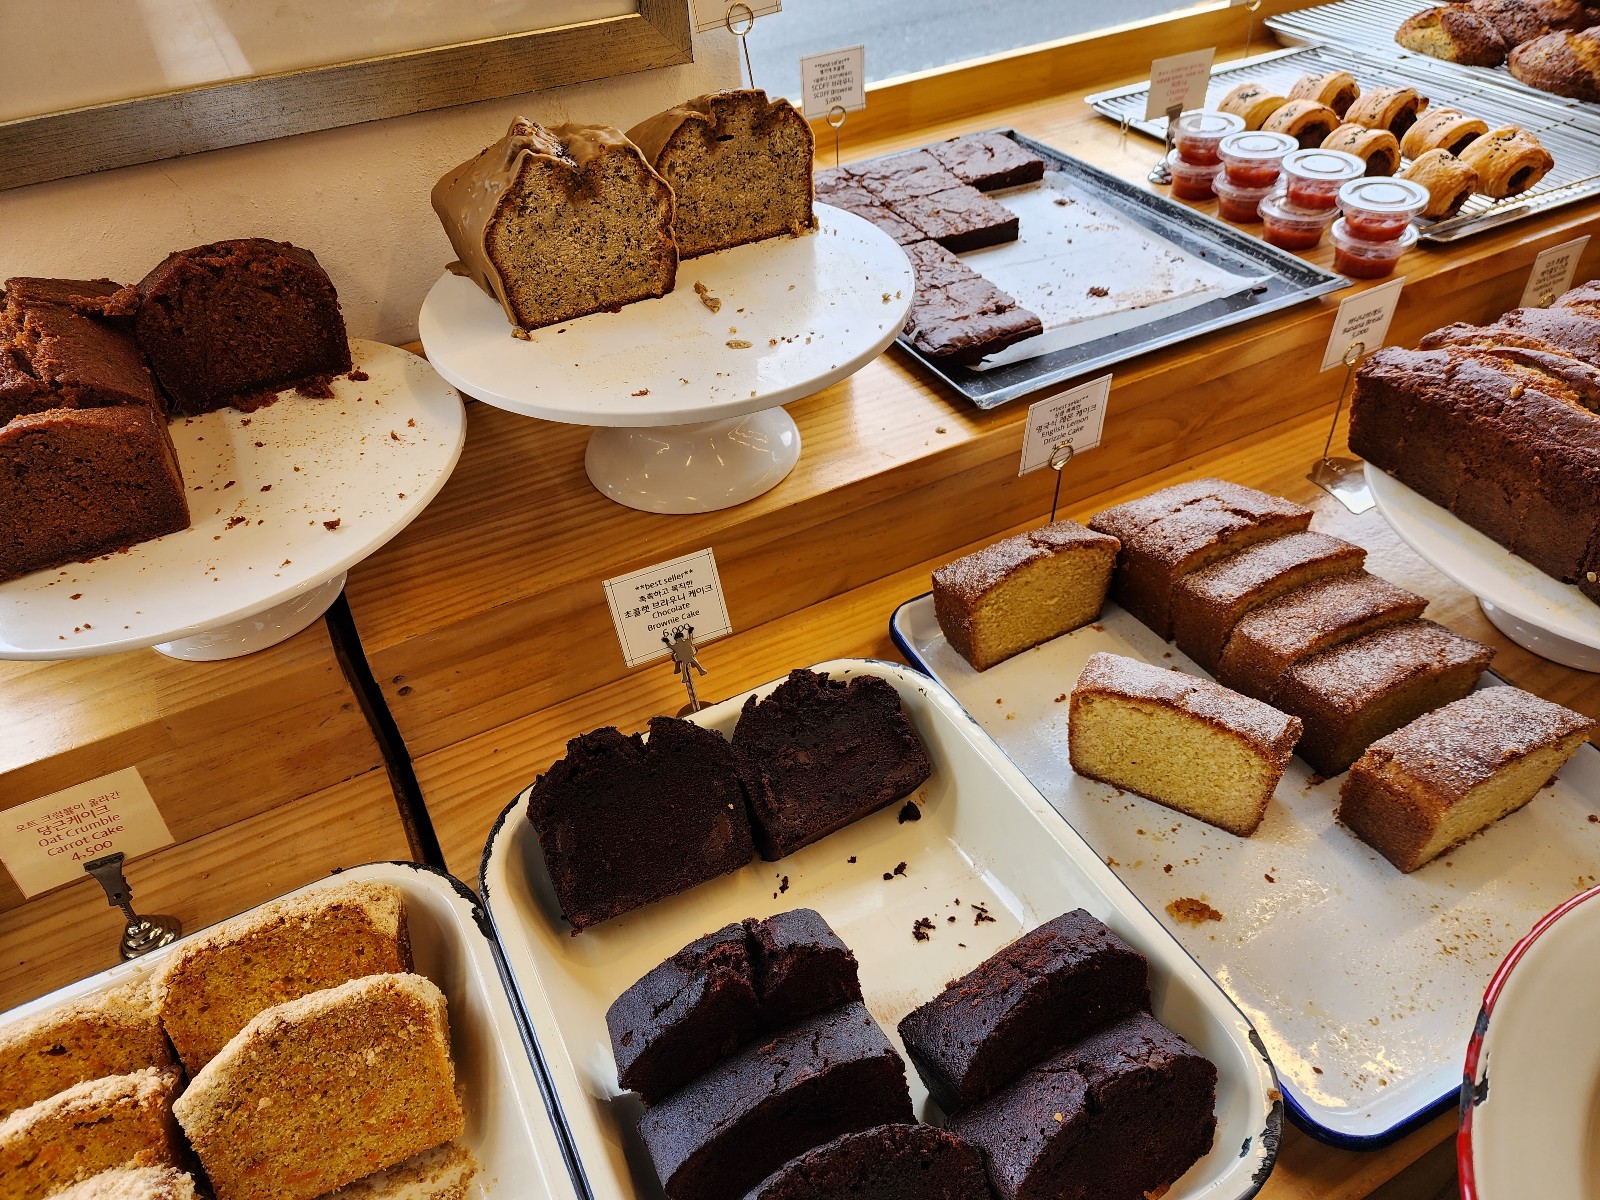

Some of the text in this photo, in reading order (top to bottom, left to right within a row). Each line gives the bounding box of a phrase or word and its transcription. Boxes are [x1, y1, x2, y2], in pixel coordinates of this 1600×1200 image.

[812, 82, 830, 92] SCOFF
[813, 90, 830, 99] SCOFF
[1076, 404, 1096, 416] 케이크
[1041, 416, 1088, 438] English Lemon
[1043, 426, 1084, 446] Drizzle Cake
[624, 584, 714, 619] 초콜렛 브라우니 케이크
[638, 580, 693, 603] 촉촉하고 묵직한
[648, 609, 700, 632] Brownie Cake
[652, 602, 690, 619] Chocolate
[662, 622, 691, 638] 6,000
[16, 790, 120, 832] 오트 크럼블이 올라간
[36, 804, 111, 836] 당근케이크
[38, 814, 120, 848] Oat Crumble
[48, 824, 124, 857] Carrot Cake
[72, 840, 112, 861] 4,500
